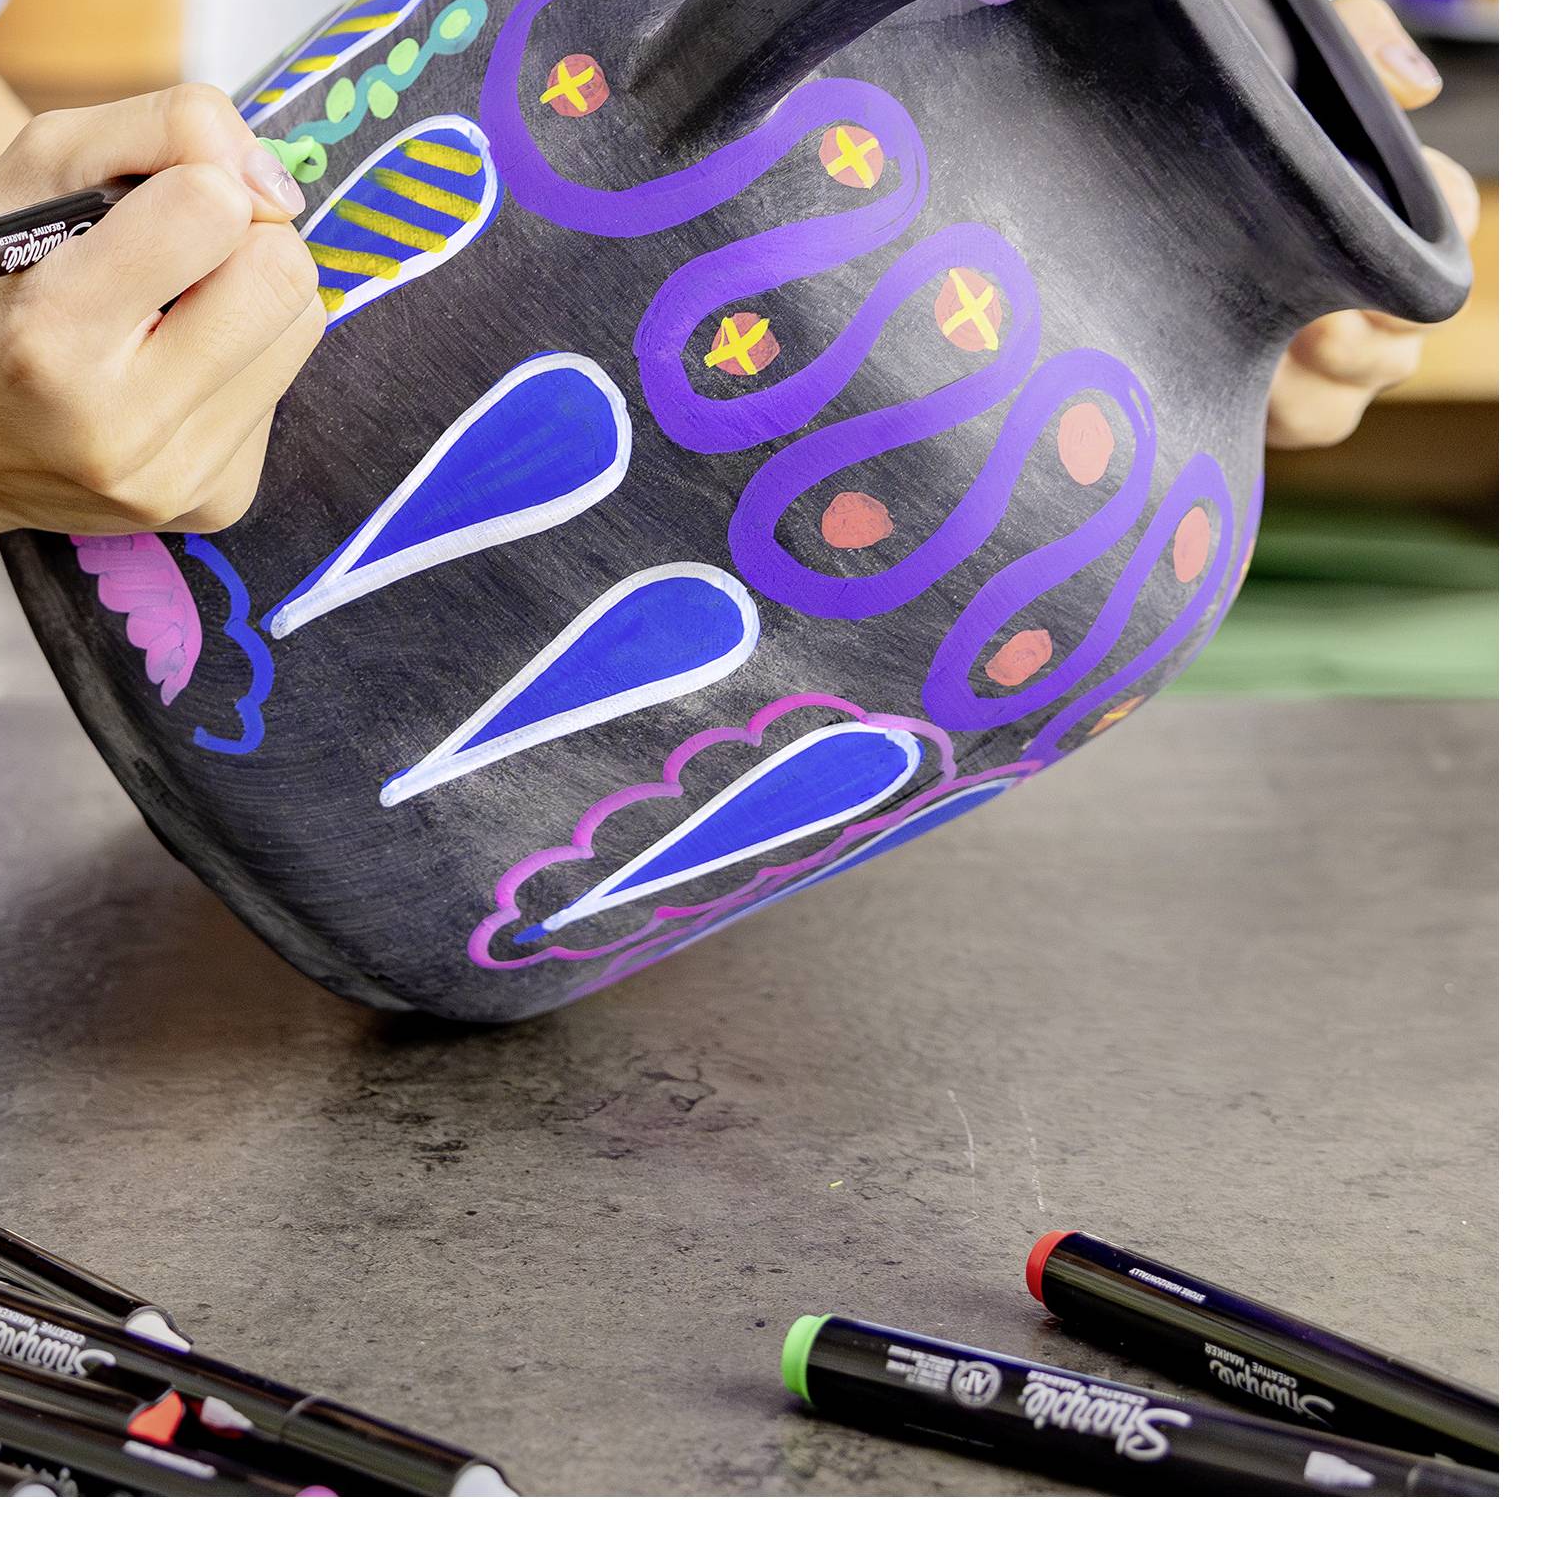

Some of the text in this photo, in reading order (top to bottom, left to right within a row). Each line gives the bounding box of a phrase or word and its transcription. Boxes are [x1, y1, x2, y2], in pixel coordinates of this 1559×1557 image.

[32, 222, 65, 236] CREATIVE
[1129, 1267, 1205, 1302] STORE HORIZONTALLY
[39, 1321, 86, 1344] CREATIVE
[1205, 1343, 1297, 1388] CREATIVE MARKER
[959, 1369, 988, 1394] AP
[1021, 1382, 1190, 1460] Sharpie
